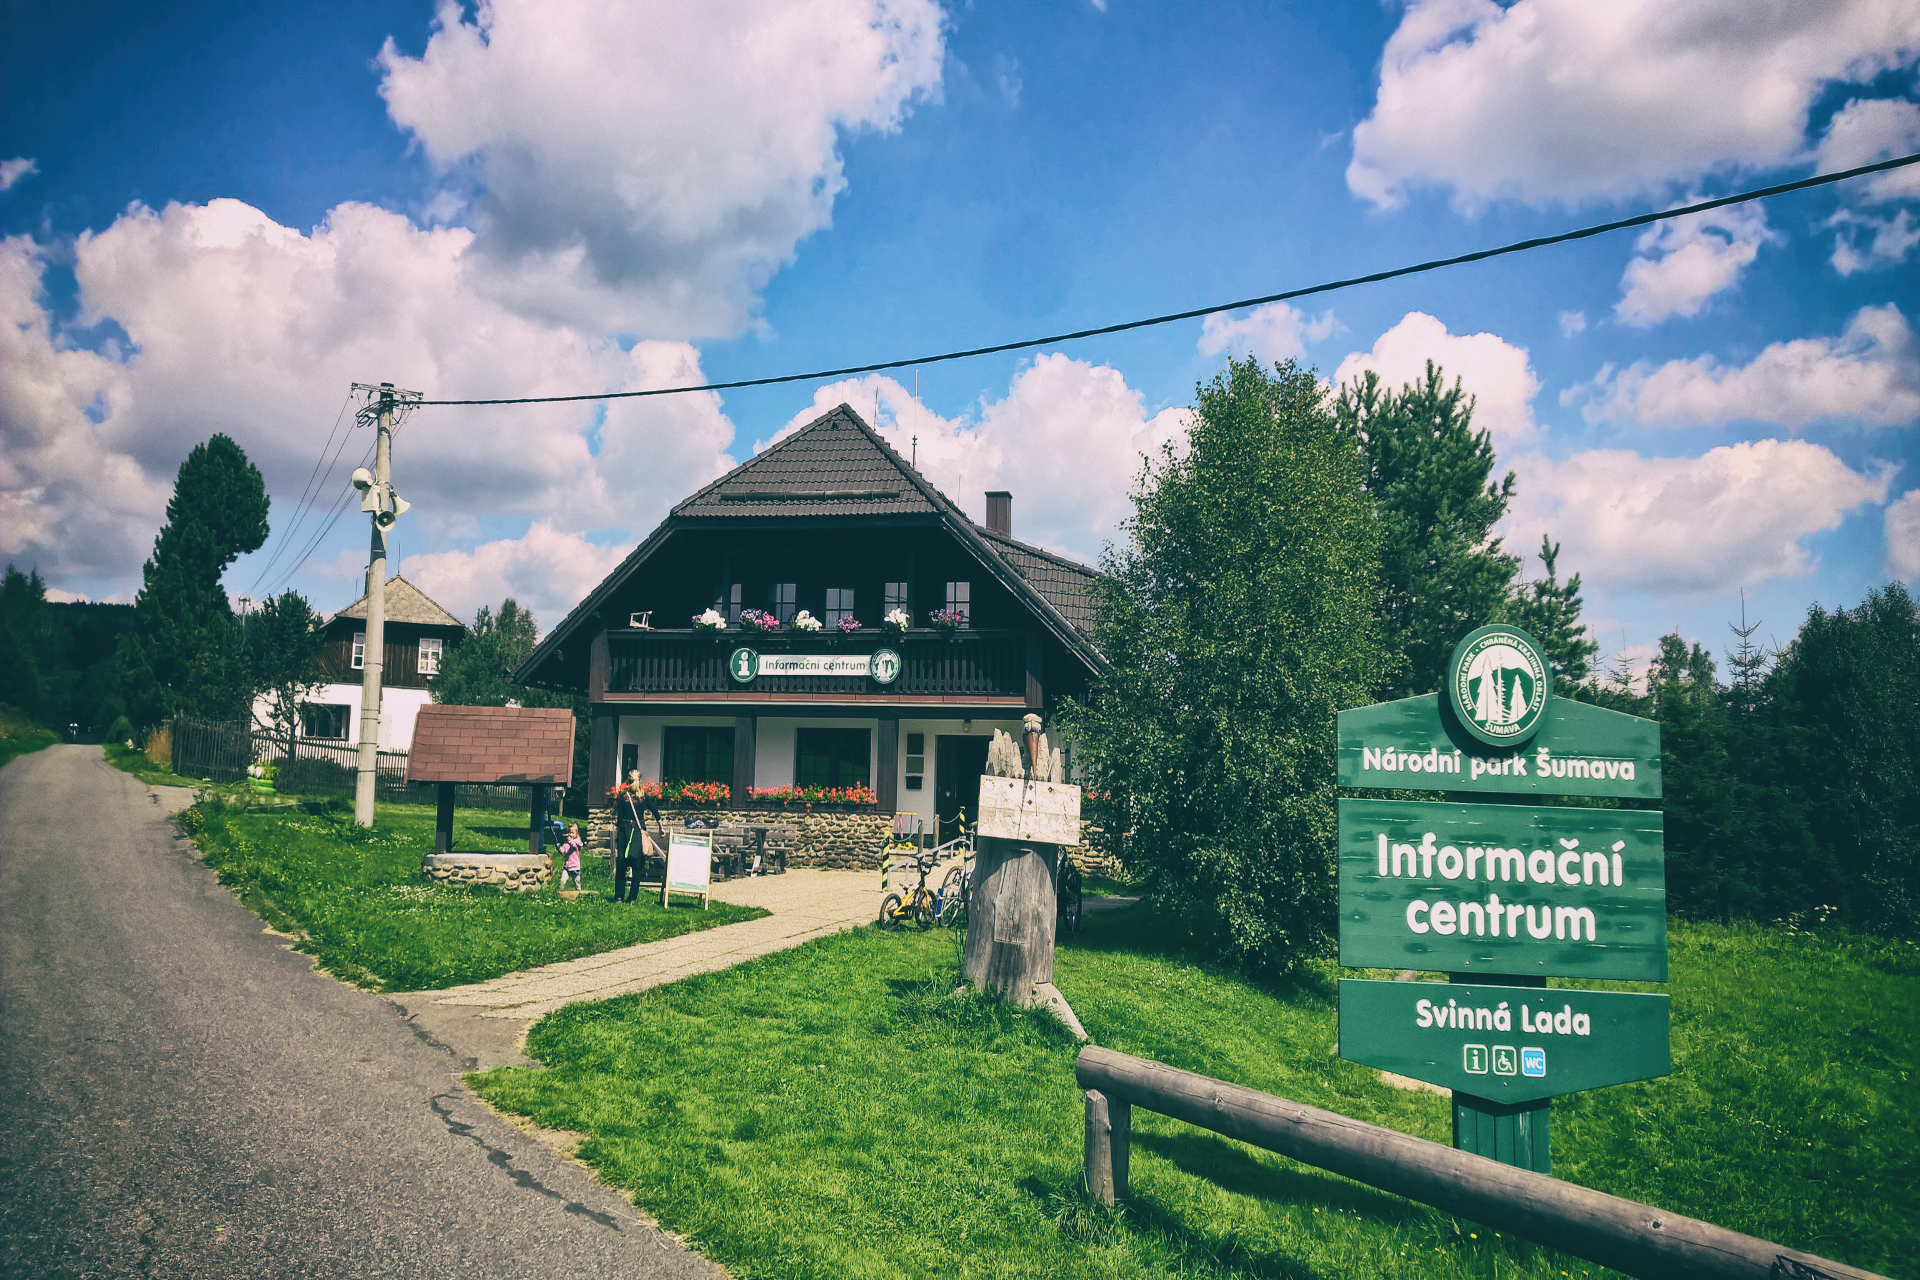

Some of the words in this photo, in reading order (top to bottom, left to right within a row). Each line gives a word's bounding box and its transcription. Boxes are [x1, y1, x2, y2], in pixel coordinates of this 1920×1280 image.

[765, 660, 820, 671] Informační
[823, 661, 866, 671] centrum
[1463, 651, 1476, 672] PARK
[1459, 672, 1474, 711] NÁRODNÍ
[1531, 680, 1543, 713] OBLAST
[1484, 722, 1521, 735] ŠUMAVA
[1363, 745, 1462, 775] Národní
[1471, 752, 1528, 781] park
[1536, 746, 1636, 781] Šumava
[1377, 832, 1626, 887] Informační
[1406, 892, 1597, 942] centrum
[1416, 999, 1512, 1033] Svinná
[1522, 1004, 1591, 1036] Lada
[1524, 1056, 1543, 1069] WC
